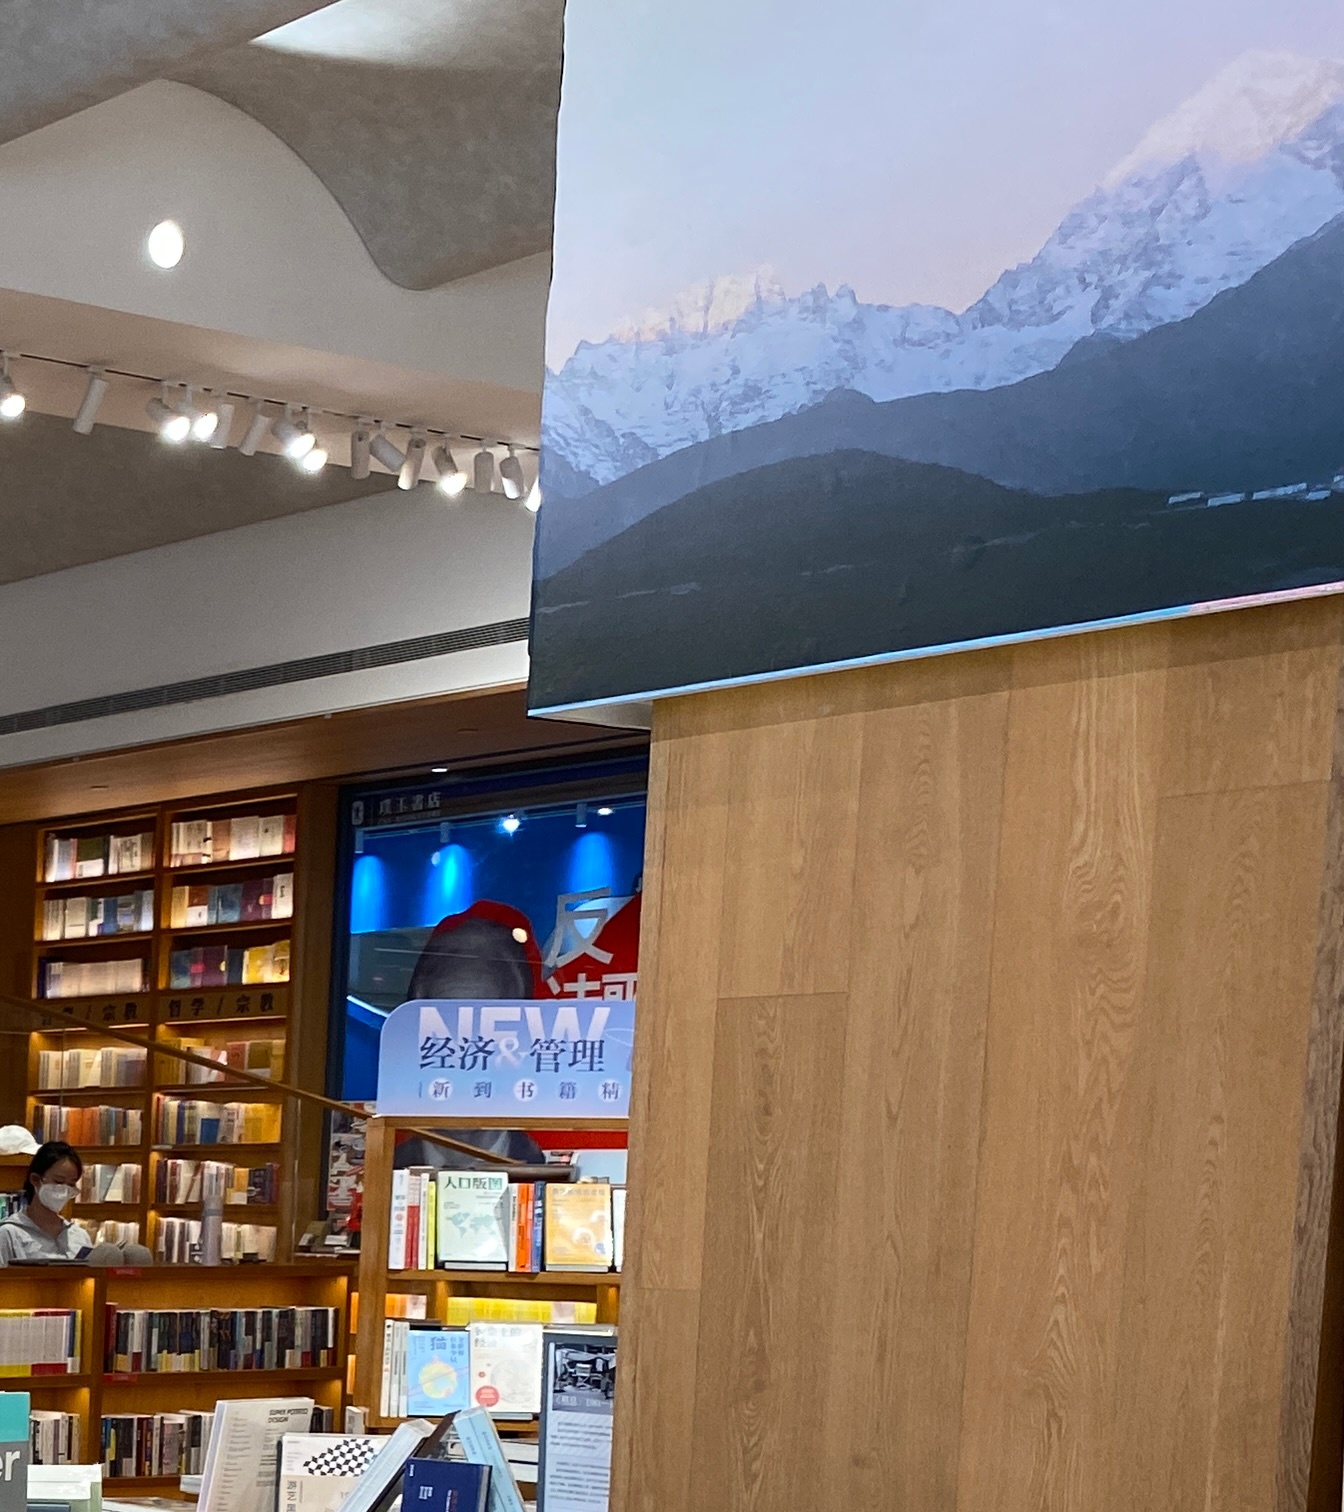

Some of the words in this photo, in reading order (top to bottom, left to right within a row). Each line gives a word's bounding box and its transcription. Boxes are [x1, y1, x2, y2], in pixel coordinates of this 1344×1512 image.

[544, 886, 614, 968] 反
[443, 1175, 503, 1192] 人口版图
